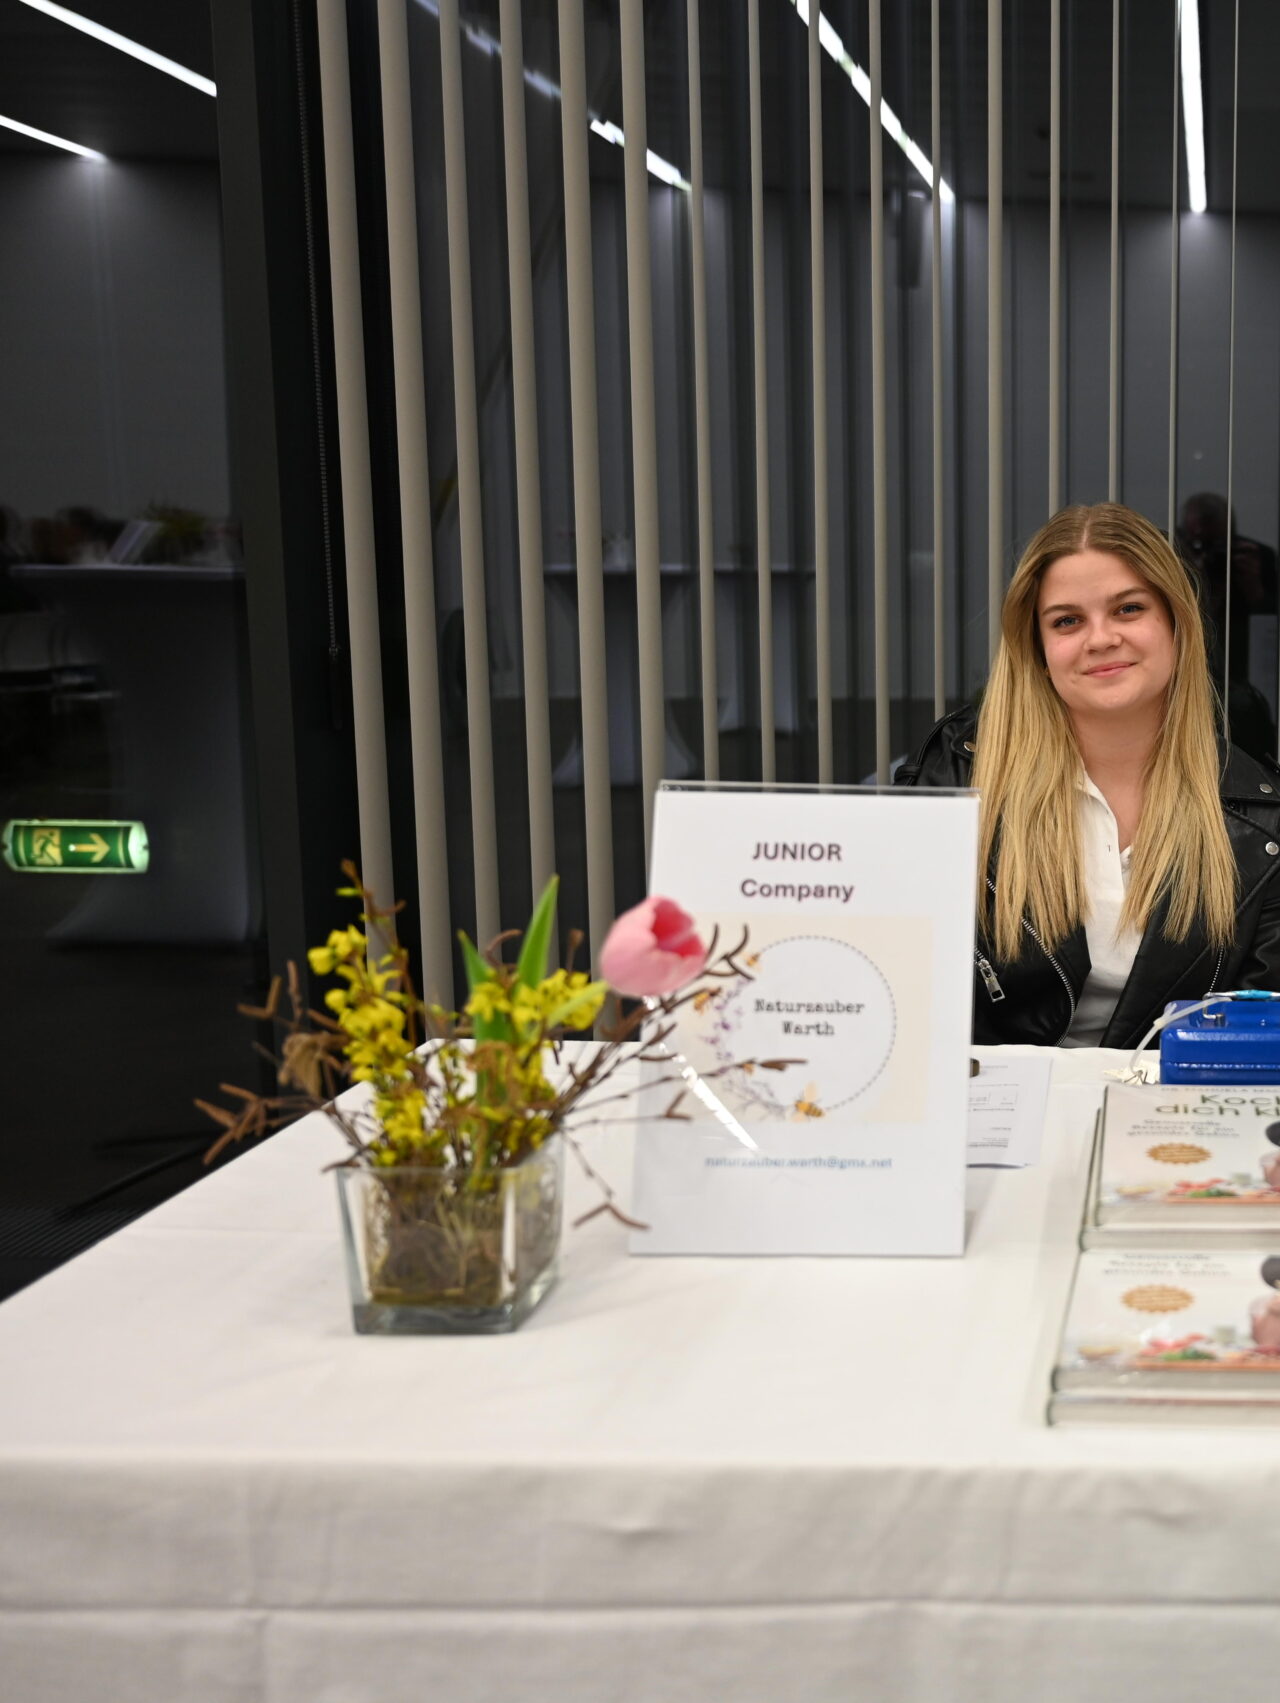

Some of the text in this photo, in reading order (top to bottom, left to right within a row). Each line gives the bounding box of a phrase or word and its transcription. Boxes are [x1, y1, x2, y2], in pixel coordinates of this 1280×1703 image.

[753, 842, 842, 861] JUNIOR
[741, 879, 855, 903] Company
[755, 999, 865, 1014] Naturzauber
[783, 1021, 835, 1036] Warth
[1156, 1104, 1240, 1116] dich
